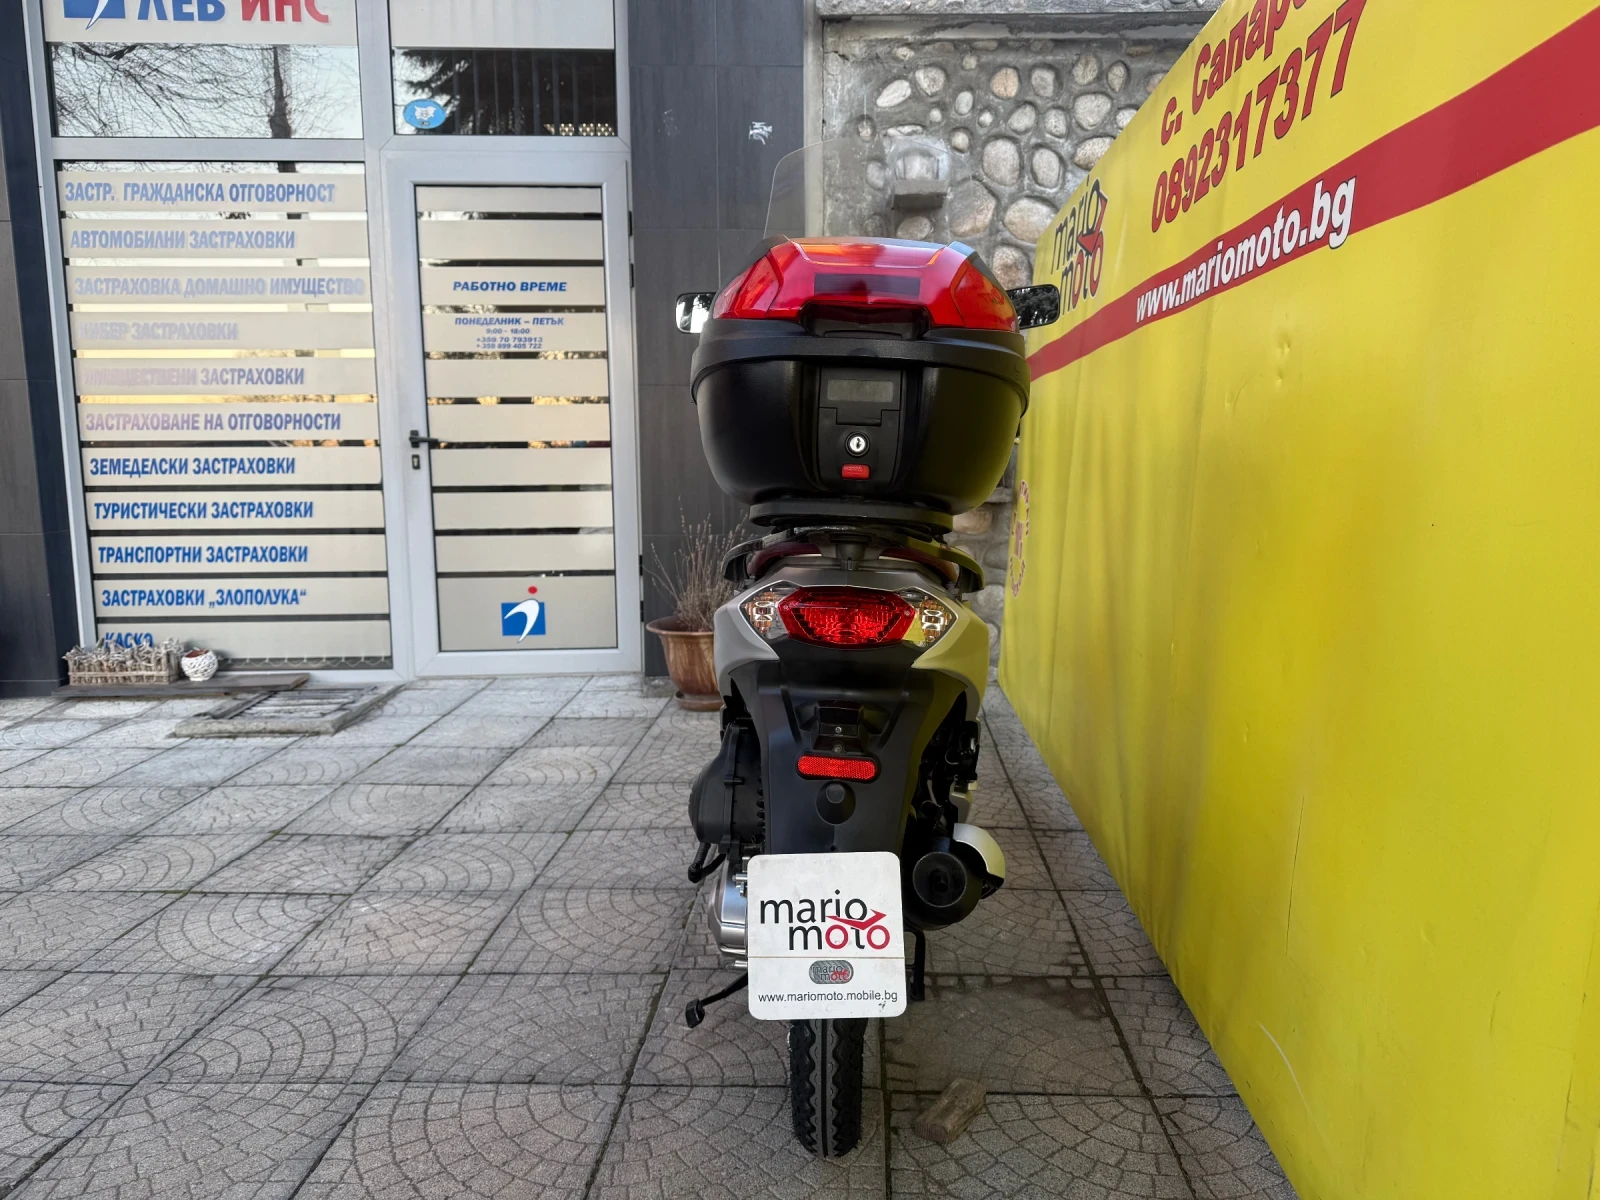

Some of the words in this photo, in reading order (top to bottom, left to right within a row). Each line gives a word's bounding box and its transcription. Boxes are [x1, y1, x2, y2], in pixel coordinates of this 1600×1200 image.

[1192, 0, 1308, 115] Сапар
[1152, 0, 1367, 233] 0892317377
[64, 182, 115, 201] ЗАСТР.
[123, 182, 225, 205] ГРАЖДАНСКА
[229, 183, 336, 203] ОТГОВОРНОСТ
[1051, 174, 1101, 275] mario
[70, 230, 186, 249] АВТОМОБИЛНИ
[189, 230, 296, 249] ЗАСТРАХОВКИ
[1136, 176, 1357, 322] www.mariomoto.bg
[74, 277, 181, 296] ЗАСТРАХОВКА
[183, 277, 267, 298] ДОМАШНО
[269, 277, 365, 299] ИМУЩЕСТВО
[453, 281, 517, 292] РАБОТНО
[520, 281, 568, 292] ВРЕМЕ
[131, 321, 239, 341] ЗАСТРАХОВКИ
[455, 317, 522, 327] ПОНЕДЕЛНИК
[532, 317, 564, 326] ПЕТЪК
[200, 367, 305, 386] ЗАСТРАХОВКИ
[86, 413, 201, 431] ЗАСТРАХОВАНЕ
[204, 413, 225, 431] НА
[228, 412, 342, 431] ОТГОВОРНОСТИ
[90, 458, 189, 478] ЗЕМЕДЕЛСКИ
[192, 457, 296, 475] ЗАСТРАХОВКИ
[94, 502, 208, 519] ТУРИСТИЧЕСКИ
[211, 501, 314, 519] ЗАСТРАХОВКИ
[98, 546, 202, 563] ТРАНСПОРТНИ
[206, 546, 309, 563] ЗАСТРАХОВКИ
[102, 589, 205, 606] ЗАСТРАХОВКИ
[760, 889, 868, 924] mario
[789, 924, 890, 951] moto
[812, 963, 843, 974] mario
[758, 989, 898, 1003] www.mariomoto.mobile.bg
